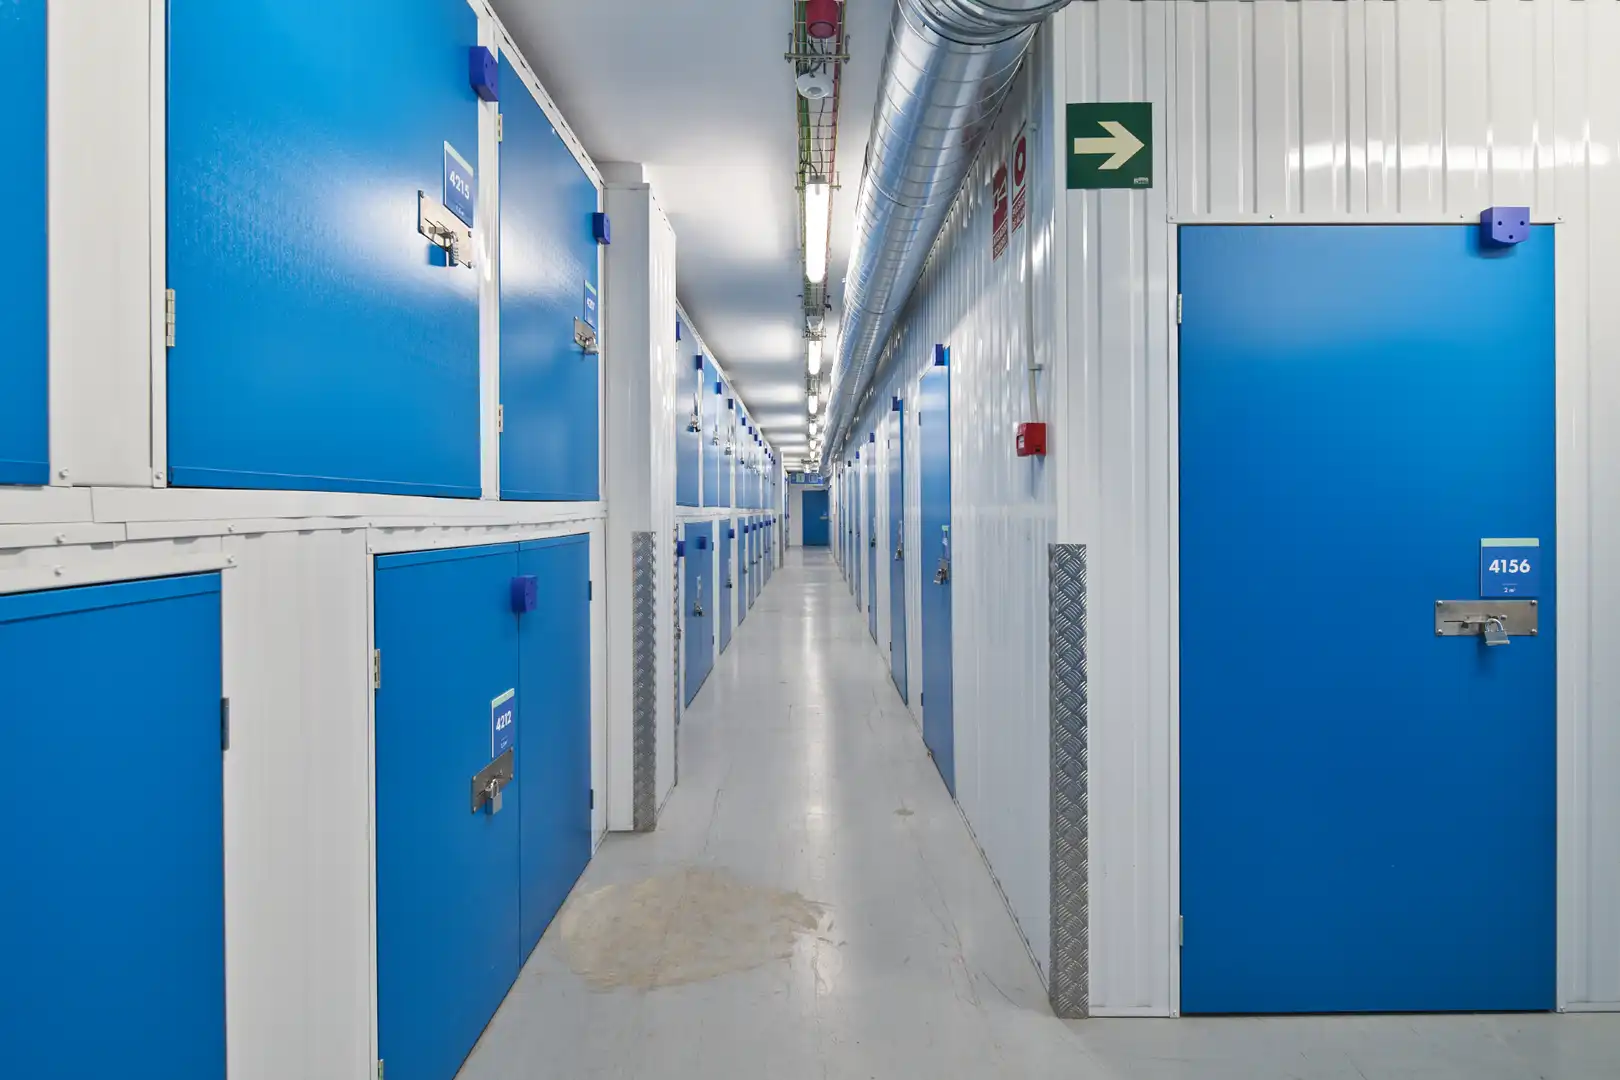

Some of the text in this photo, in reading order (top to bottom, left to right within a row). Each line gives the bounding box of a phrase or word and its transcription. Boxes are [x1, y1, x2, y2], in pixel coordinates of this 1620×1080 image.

[449, 170, 470, 200] 4215
[1488, 559, 1531, 574] 4156
[495, 710, 512, 731] 4212
